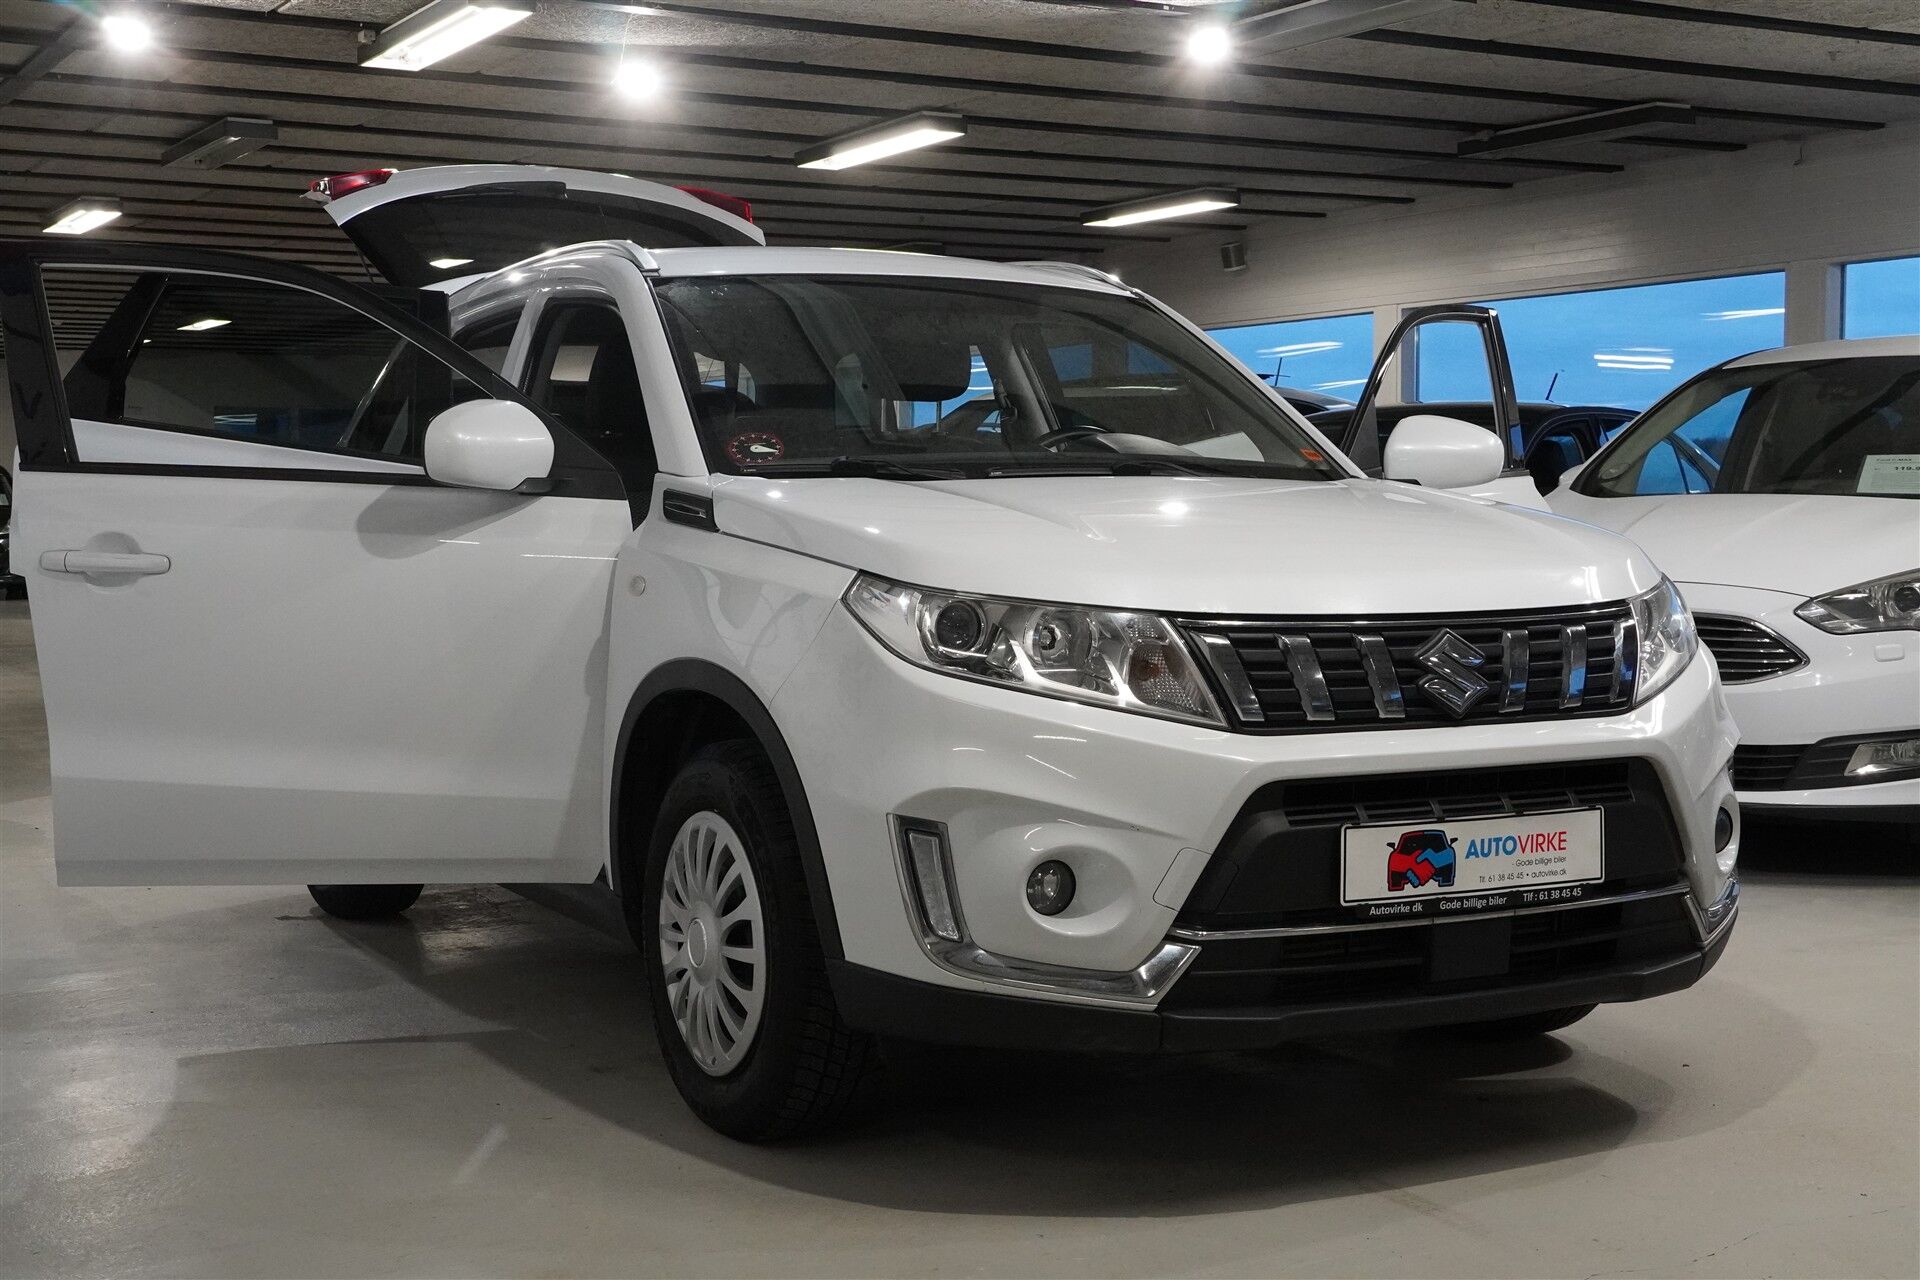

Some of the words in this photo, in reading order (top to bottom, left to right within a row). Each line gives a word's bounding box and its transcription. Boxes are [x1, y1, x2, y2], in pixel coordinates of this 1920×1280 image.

[1465, 831, 1568, 859] AUTOVIRKE
[1515, 859, 1534, 867] Gode
[1534, 857, 1552, 866] billige
[1497, 873, 1506, 882] 38
[1507, 872, 1515, 880] 45
[1516, 871, 1524, 879] 45
[1369, 904, 1410, 916] Autovirke
[1440, 900, 1461, 910] Gode
[1463, 898, 1487, 908] billige
[1489, 896, 1507, 906] biler
[1539, 890, 1548, 900] 61
[1550, 889, 1560, 899] 38
[1561, 888, 1571, 898] 45
[1572, 887, 1582, 896] 45
